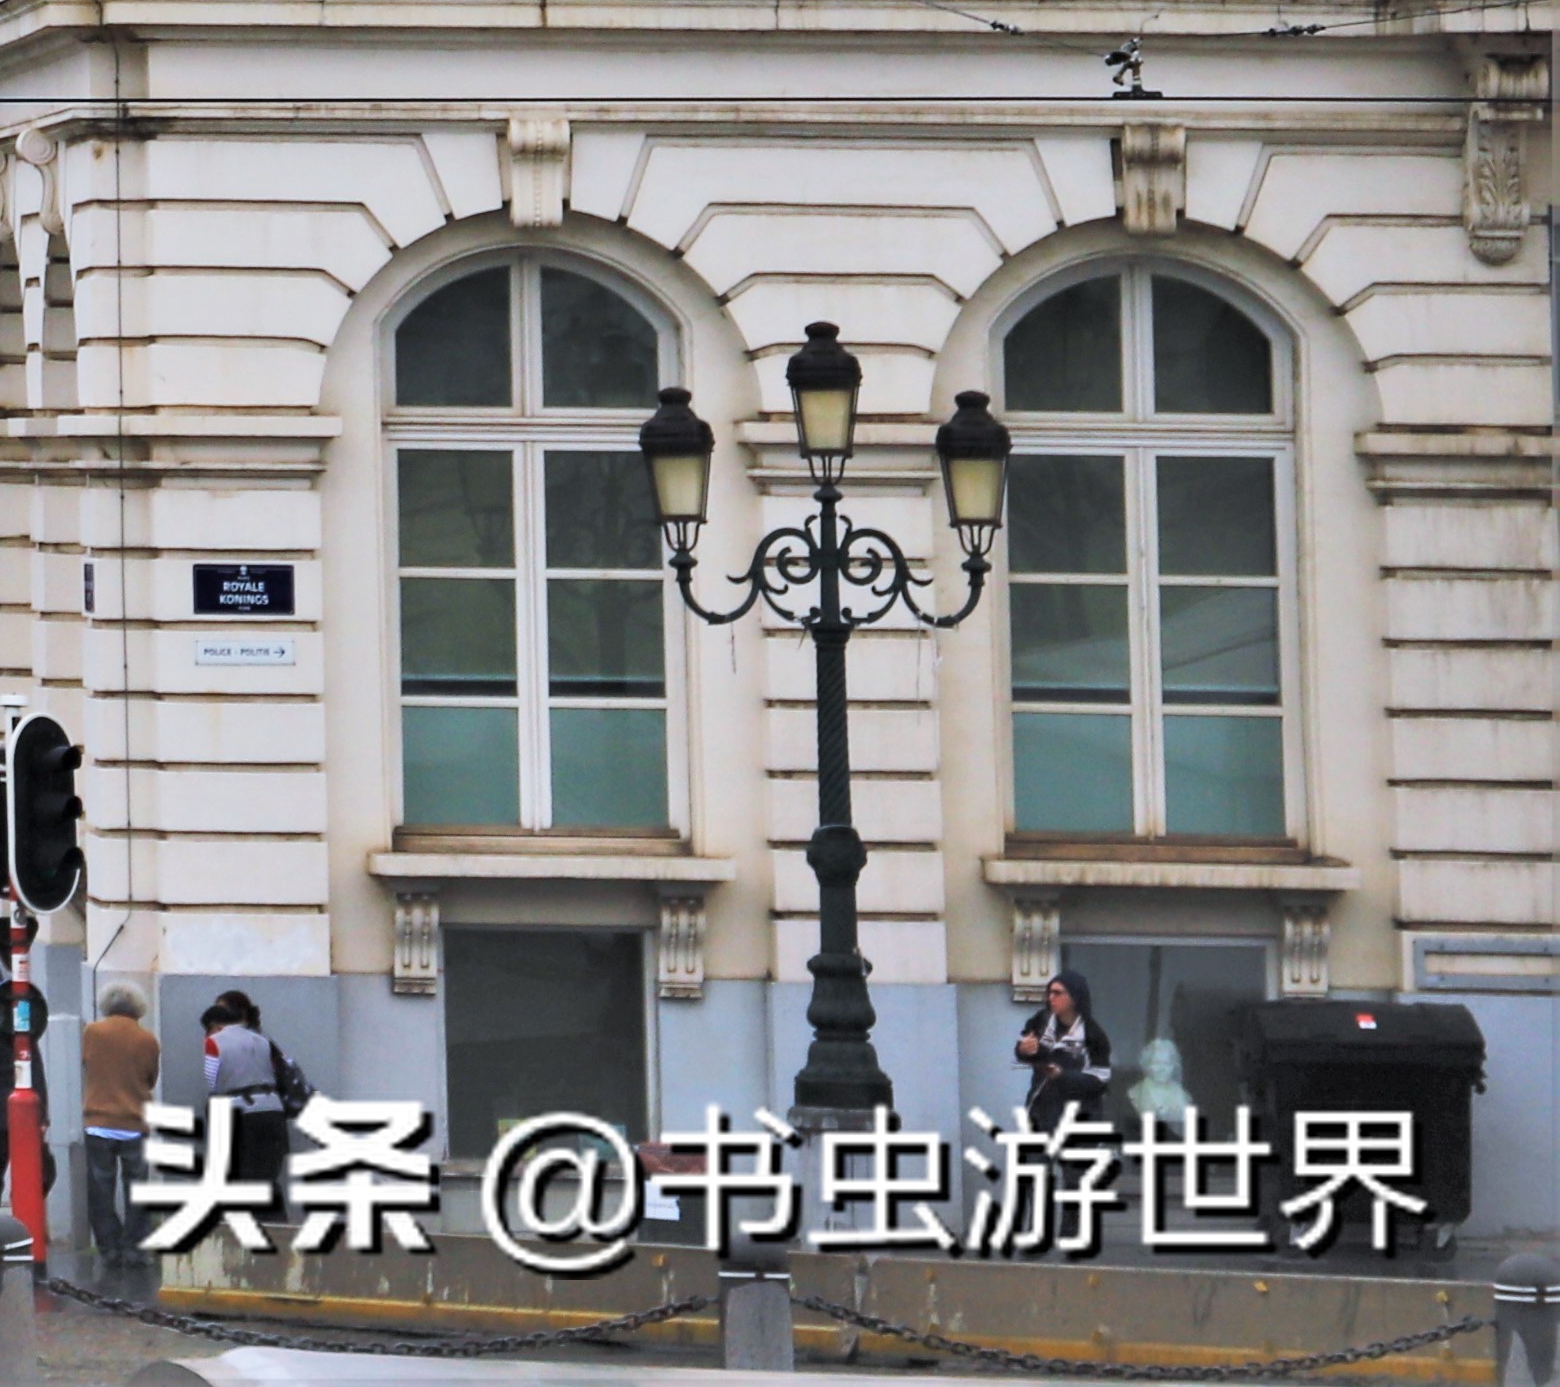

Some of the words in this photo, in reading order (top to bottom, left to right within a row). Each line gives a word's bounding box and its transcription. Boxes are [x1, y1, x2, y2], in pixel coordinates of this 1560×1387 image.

[223, 581, 265, 592] ROYALE
[219, 594, 269, 605] KONINGS
[203, 648, 232, 656] POLICE
